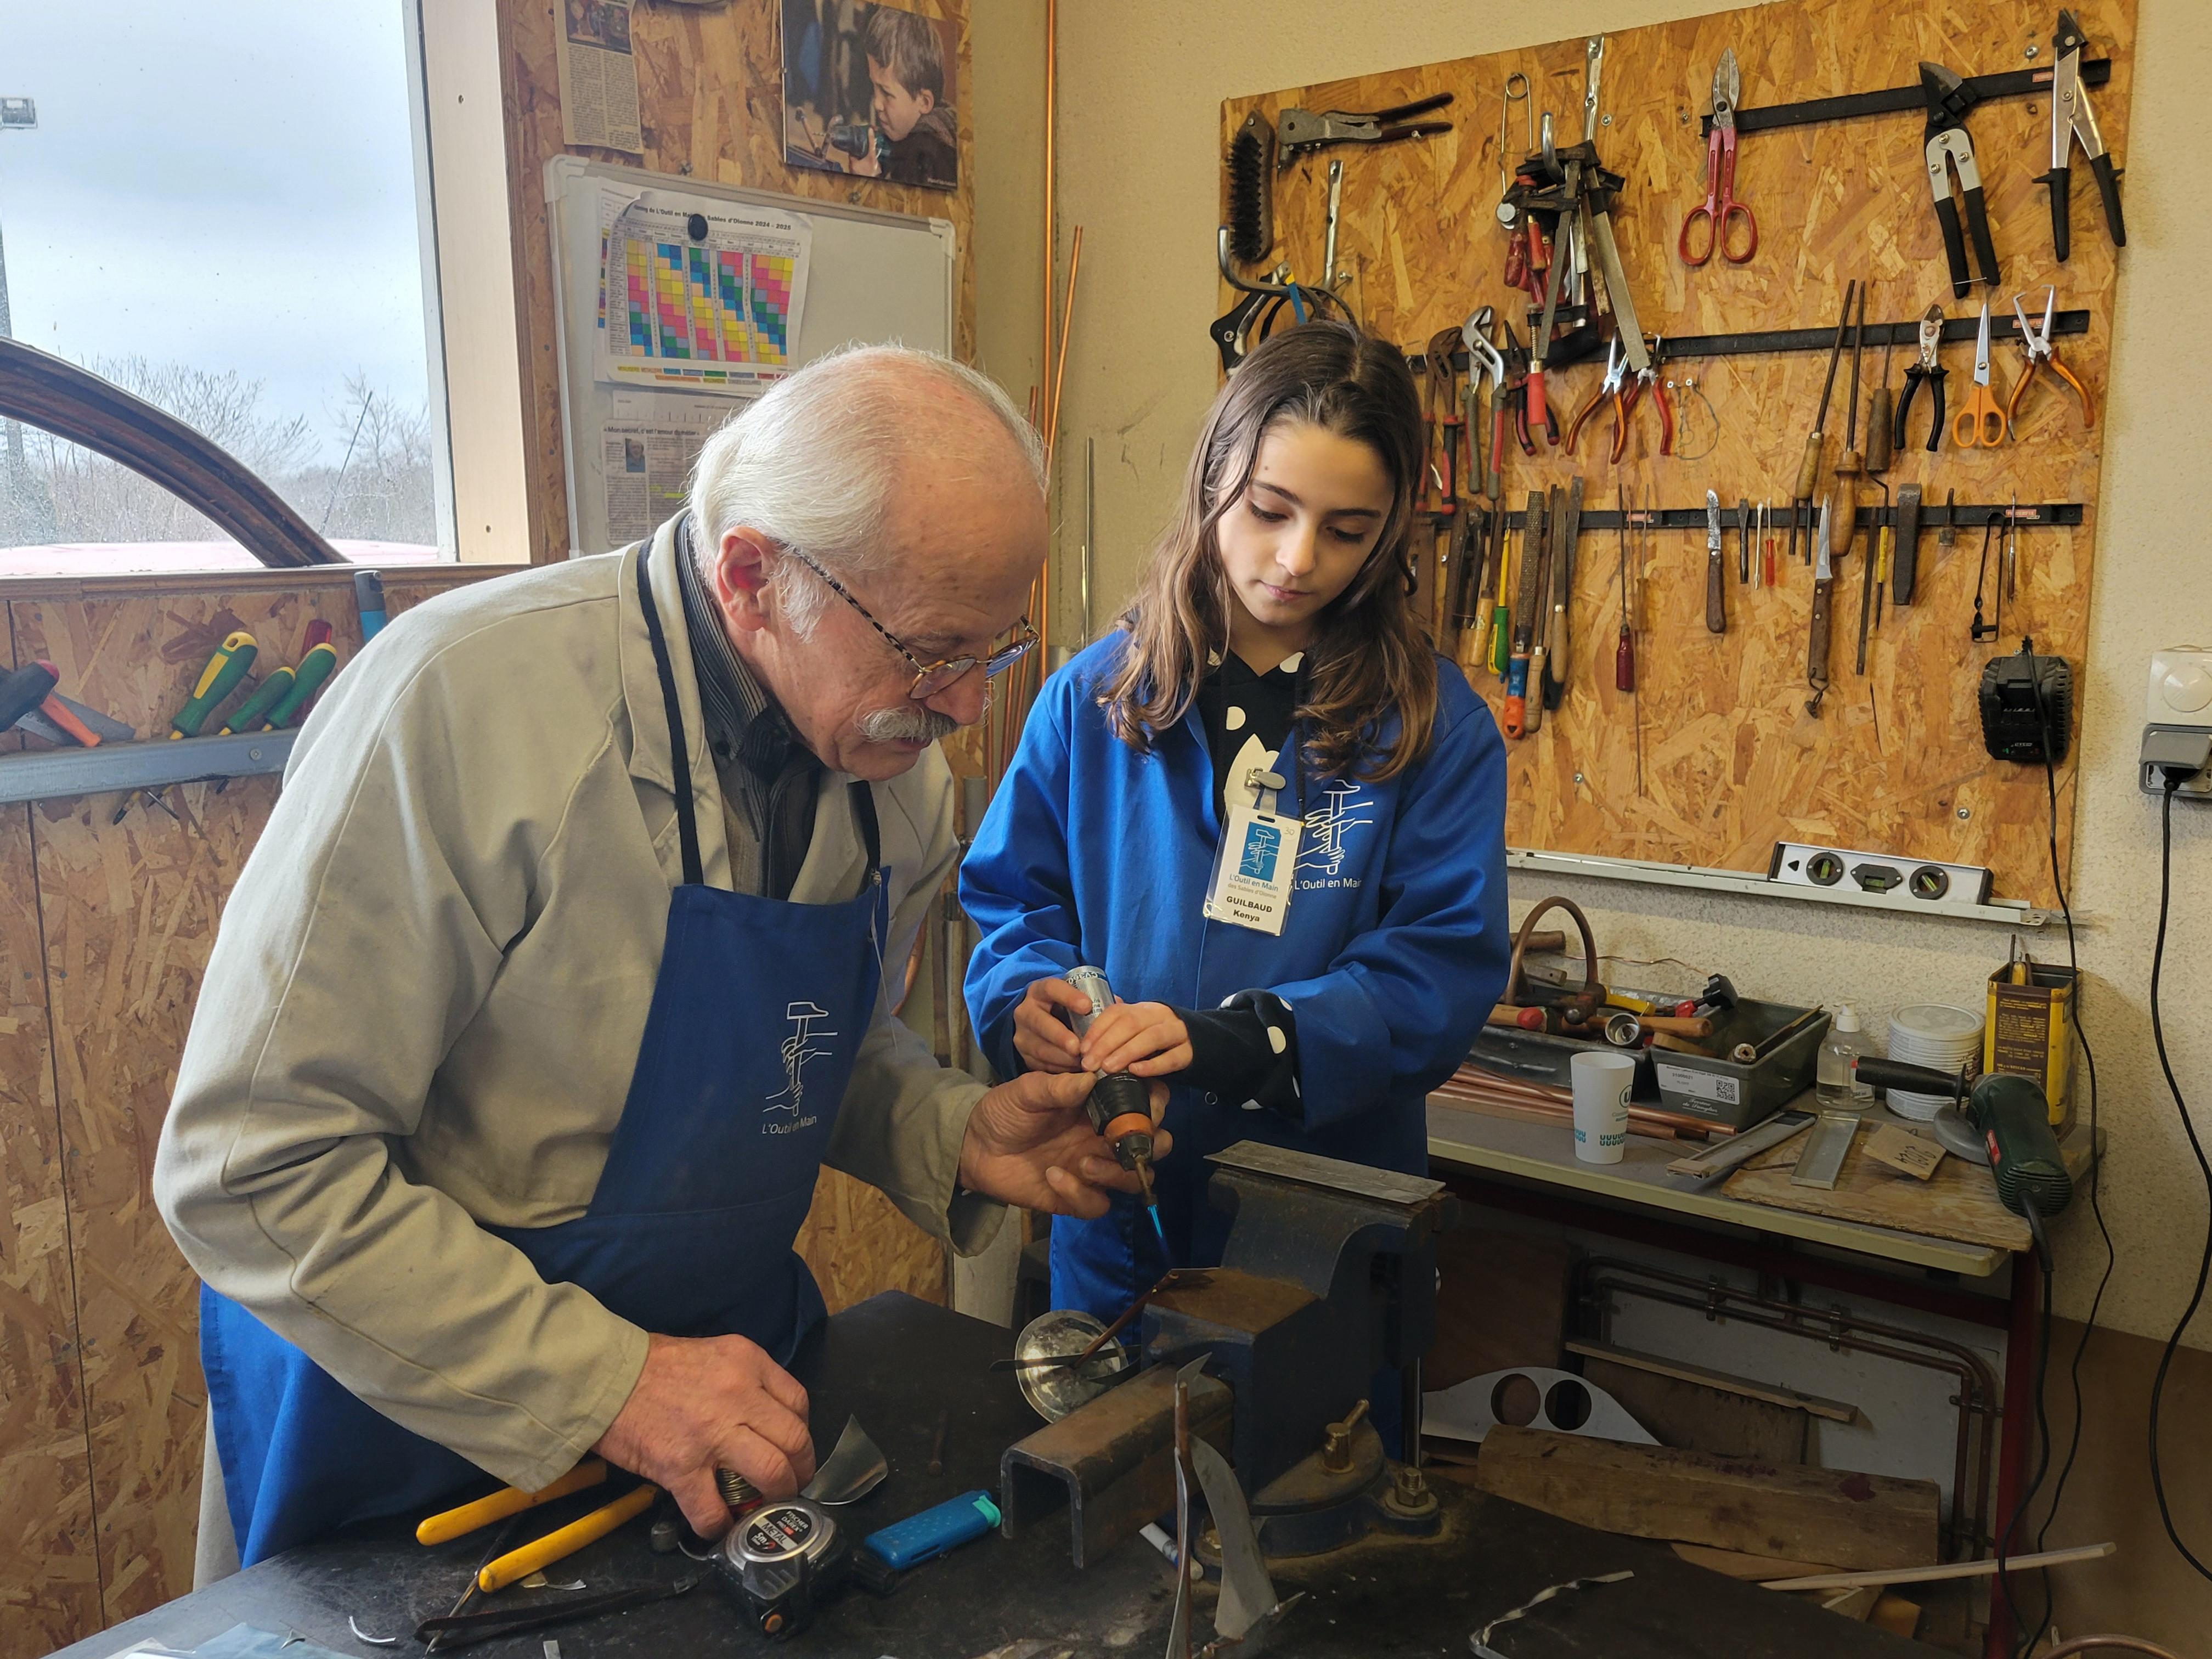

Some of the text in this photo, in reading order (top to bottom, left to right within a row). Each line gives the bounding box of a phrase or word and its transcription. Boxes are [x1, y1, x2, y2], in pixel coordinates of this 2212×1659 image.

[656, 207, 673, 216] L'Outil
[707, 215, 726, 223] Sables
[1284, 827, 1295, 836] 30
[1229, 873, 1251, 884] L'Outil
[1261, 882, 1278, 891] Main
[1238, 885, 1254, 893] Sables
[1294, 878, 1325, 890] L'Outil
[1227, 896, 1272, 912] GUILBAUD
[1233, 909, 1260, 922] Kenya
[762, 1123, 792, 1134] L'Outil
[800, 1116, 817, 1128] Main
[786, 1510, 809, 1529] FISCHER
[761, 1522, 787, 1544] METAL
